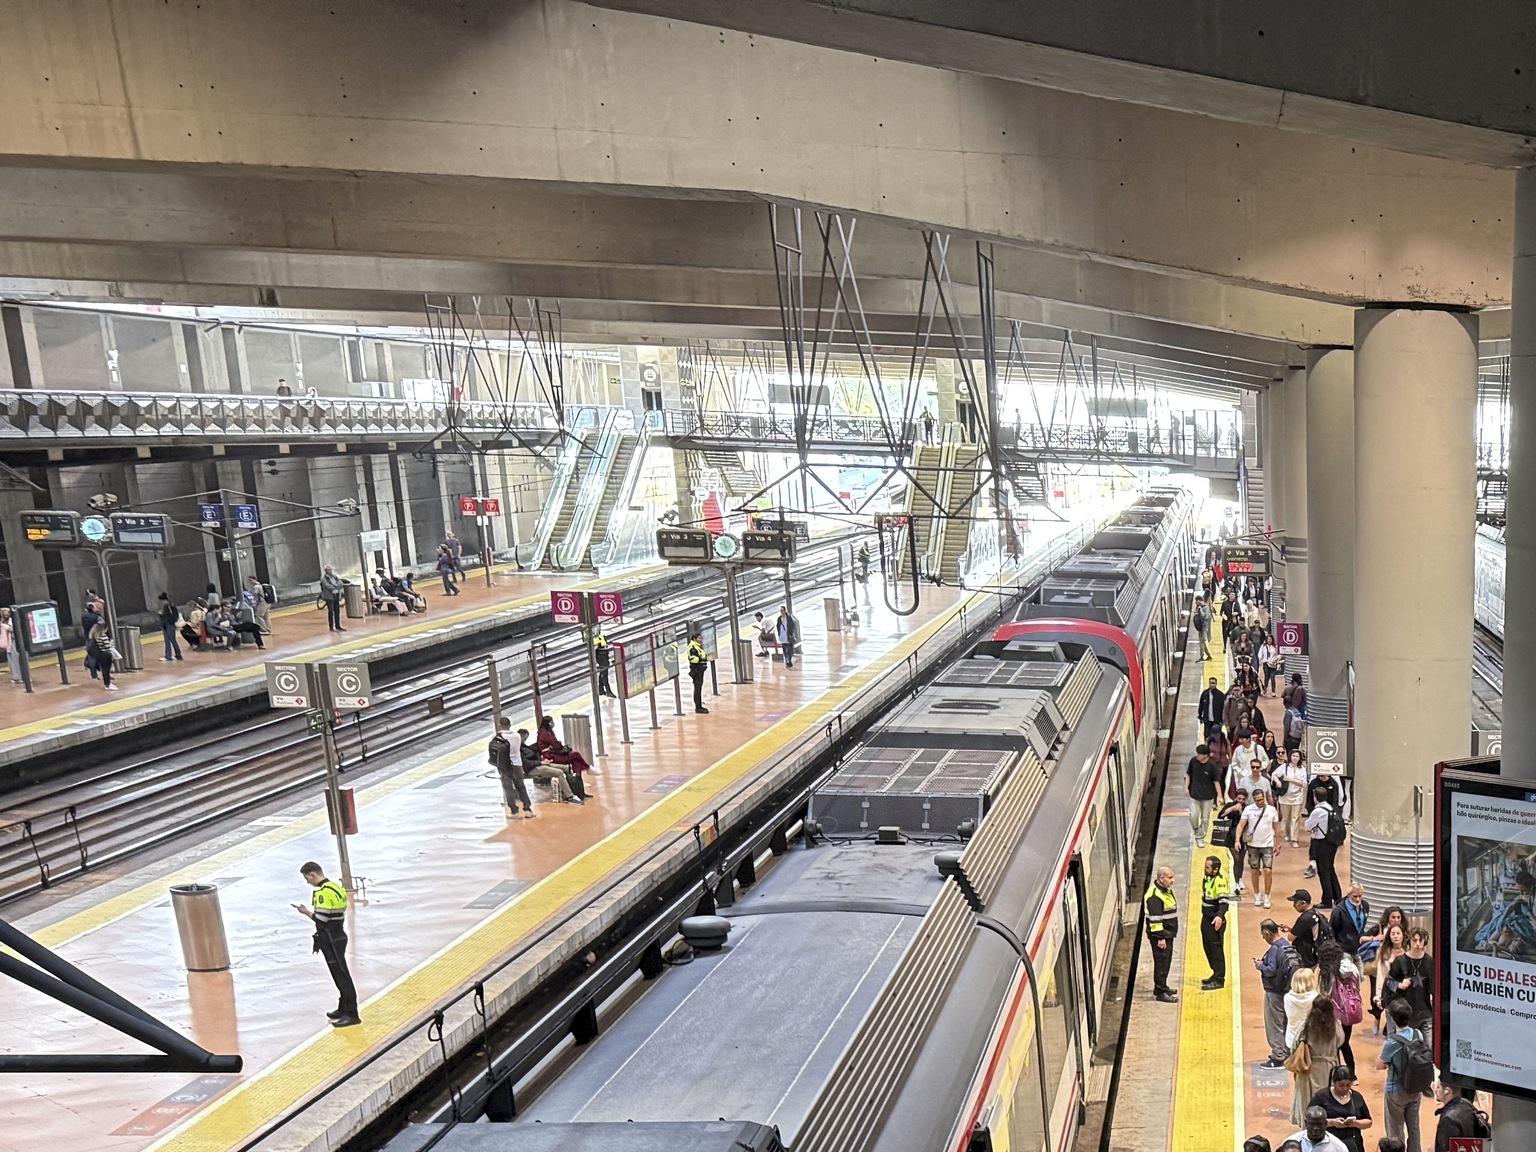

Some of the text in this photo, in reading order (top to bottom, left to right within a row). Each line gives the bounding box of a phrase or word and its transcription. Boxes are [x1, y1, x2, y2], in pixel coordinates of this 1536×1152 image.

[1456, 802, 1469, 810] Para
[1470, 804, 1490, 812] suturar
[1490, 805, 1511, 815] heridas
[1498, 816, 1516, 824] pinzas
[1456, 962, 1481, 977] TUS
[1456, 977, 1514, 1000] TAMBIÉN
[1457, 998, 1506, 1014] Independencia
